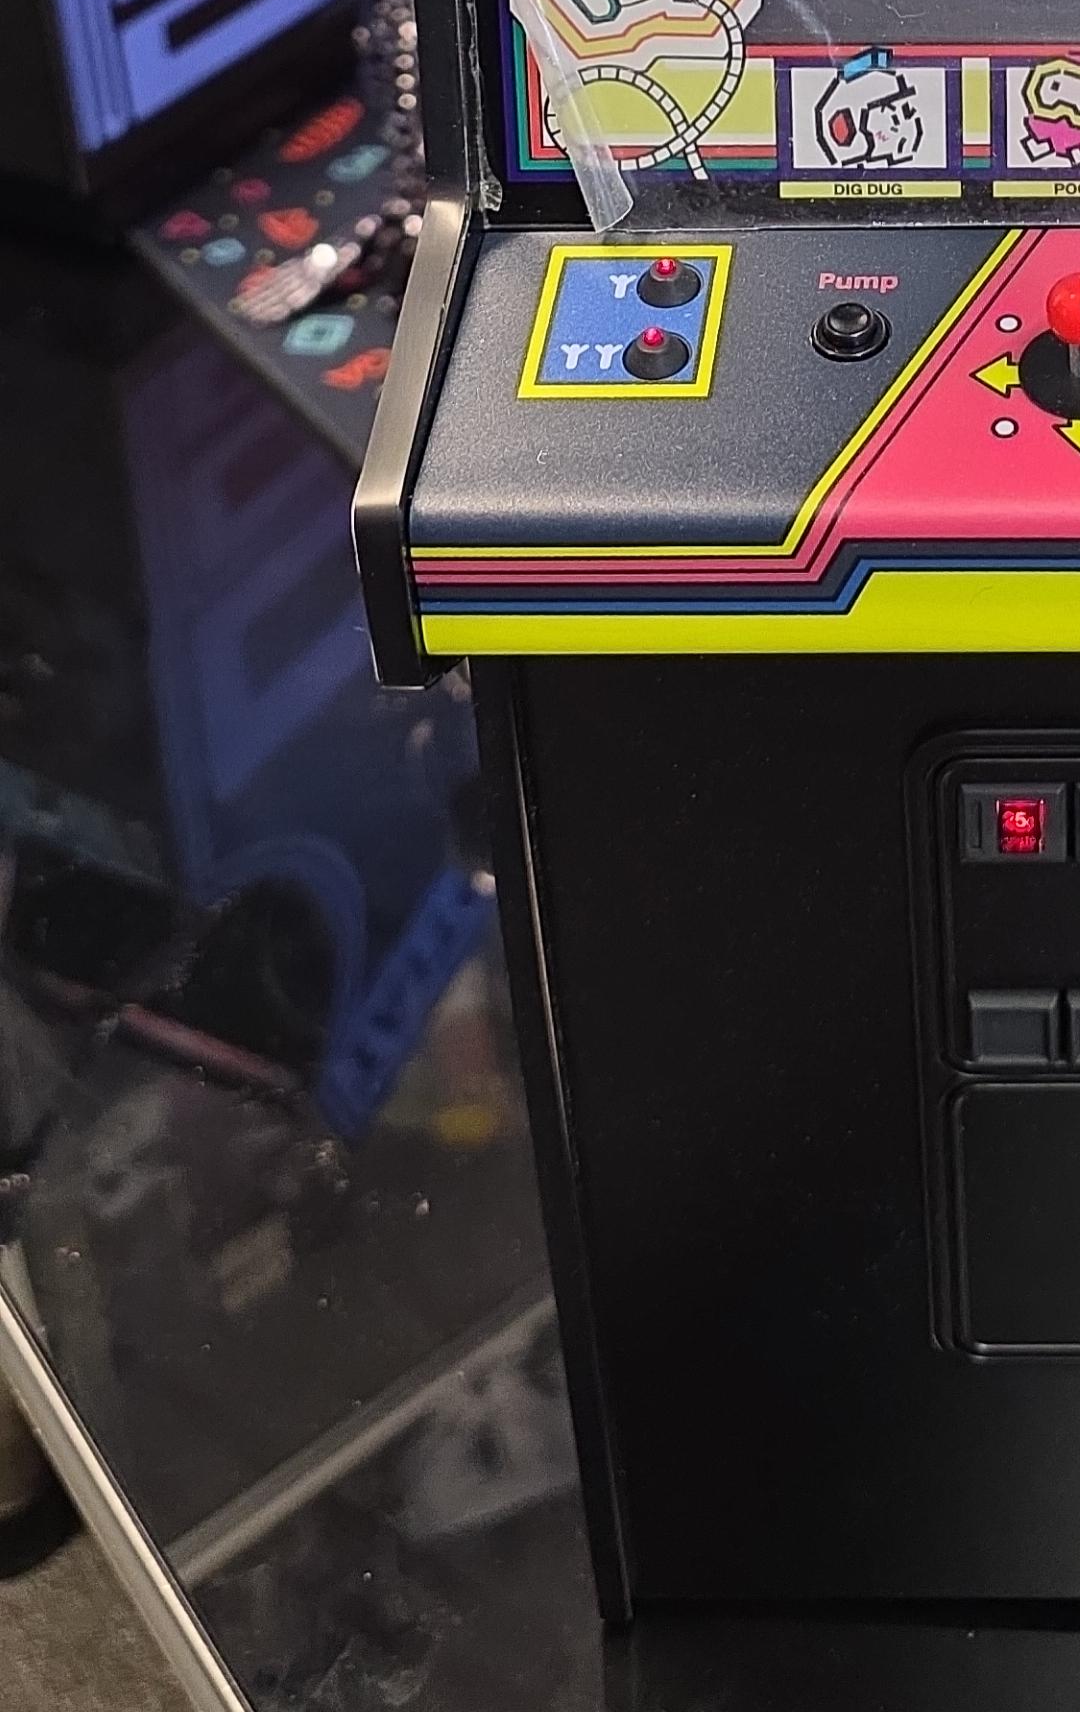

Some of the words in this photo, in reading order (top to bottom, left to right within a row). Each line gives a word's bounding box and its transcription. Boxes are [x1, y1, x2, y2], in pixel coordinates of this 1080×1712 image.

[833, 182, 862, 196] DIG
[866, 182, 904, 196] DUG
[819, 272, 899, 293] Pump
